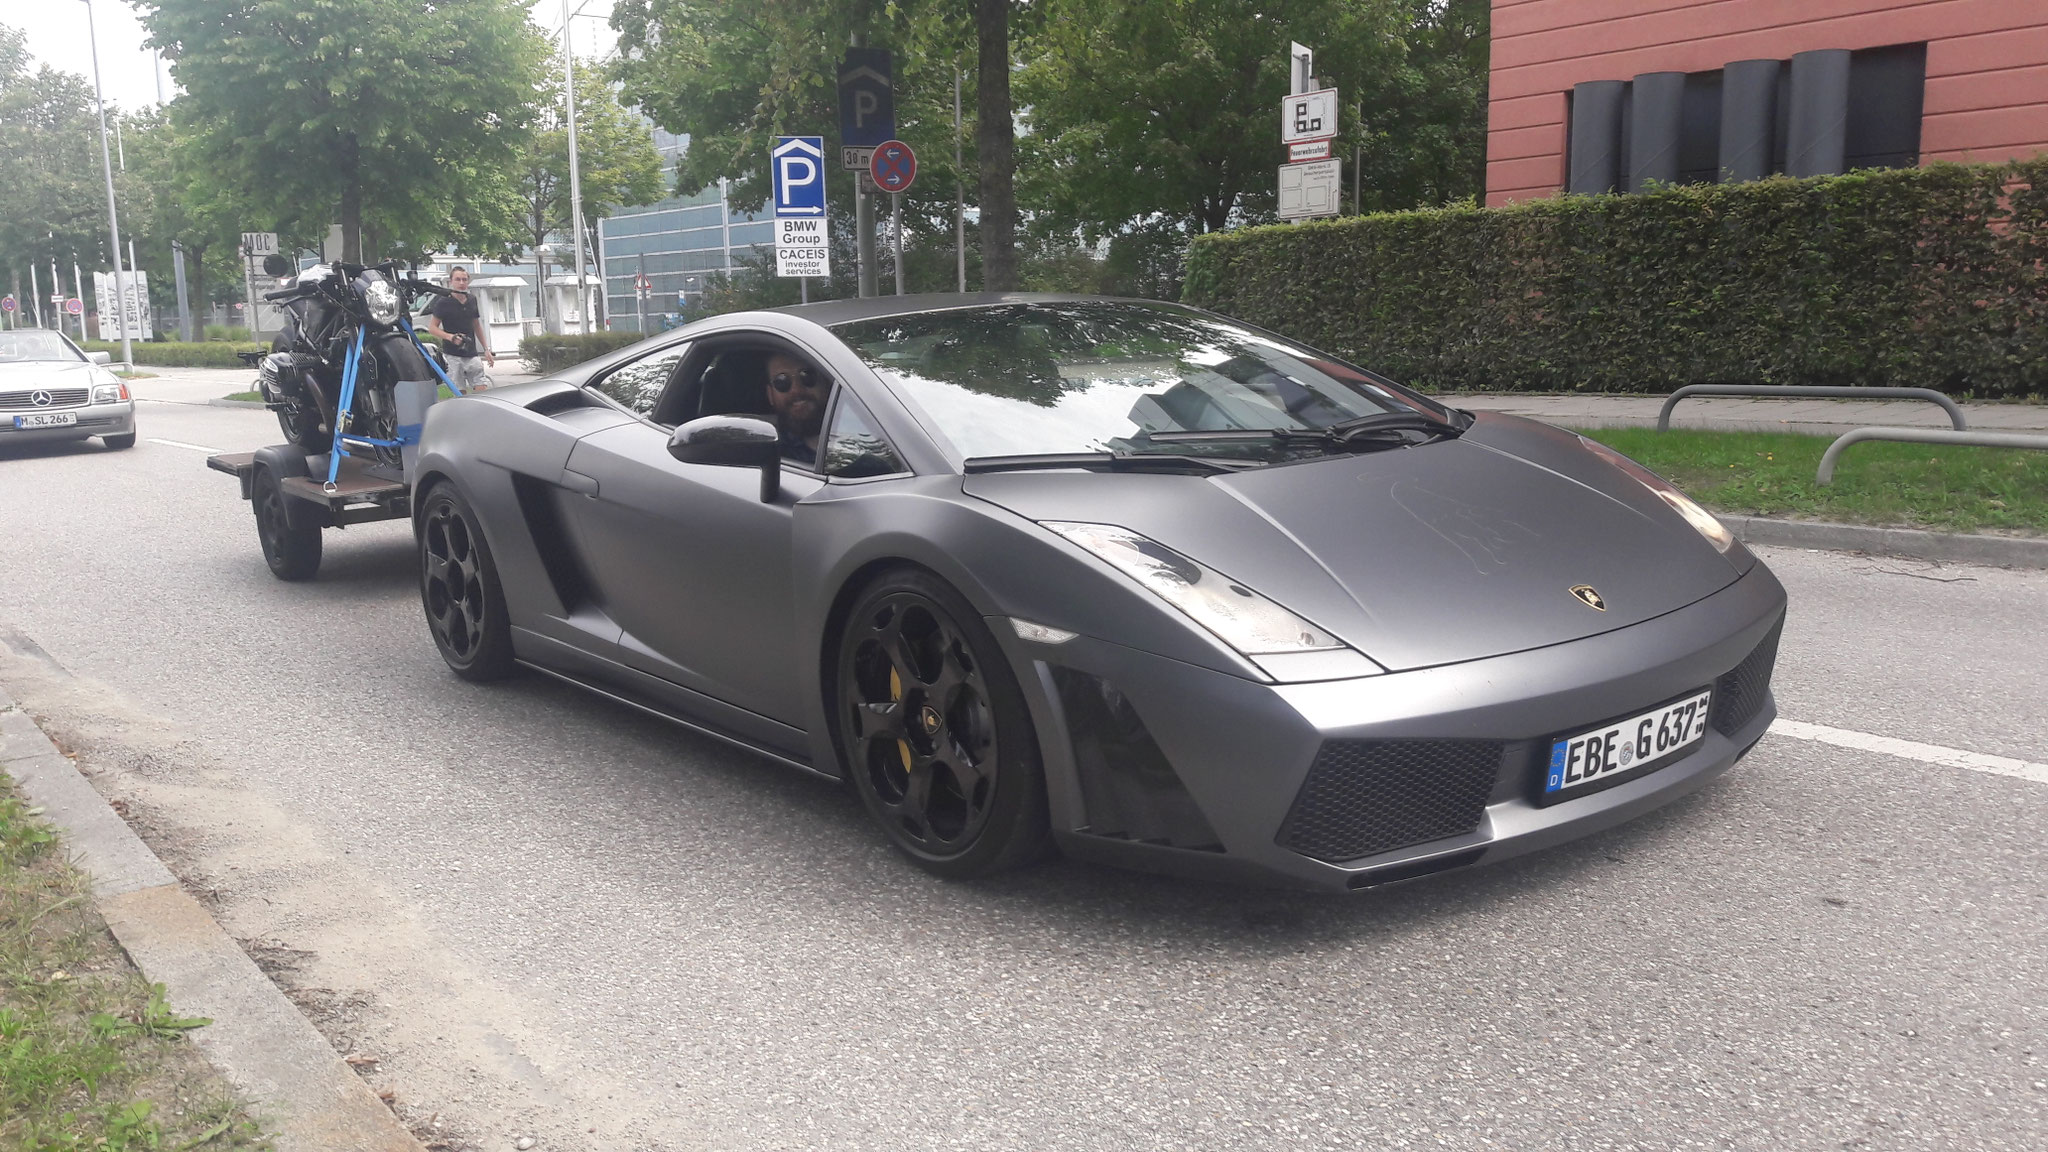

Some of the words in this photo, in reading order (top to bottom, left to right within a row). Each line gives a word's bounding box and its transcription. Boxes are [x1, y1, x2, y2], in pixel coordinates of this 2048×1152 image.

[855, 90, 877, 128] P
[846, 151, 858, 165] 30
[861, 155, 869, 165] m
[780, 157, 816, 204] P
[784, 220, 817, 232] BMW
[243, 234, 270, 251] MOC
[782, 233, 821, 245] Group
[780, 249, 826, 259] CACEIS
[785, 260, 820, 268] investor
[785, 267, 822, 275] services
[20, 417, 29, 426] M
[34, 416, 49, 425] SL
[49, 414, 69, 424] 266
[1565, 729, 1620, 784] EBE
[1635, 718, 1654, 760] G
[1656, 701, 1697, 752] 637
[1550, 774, 1558, 787] D
